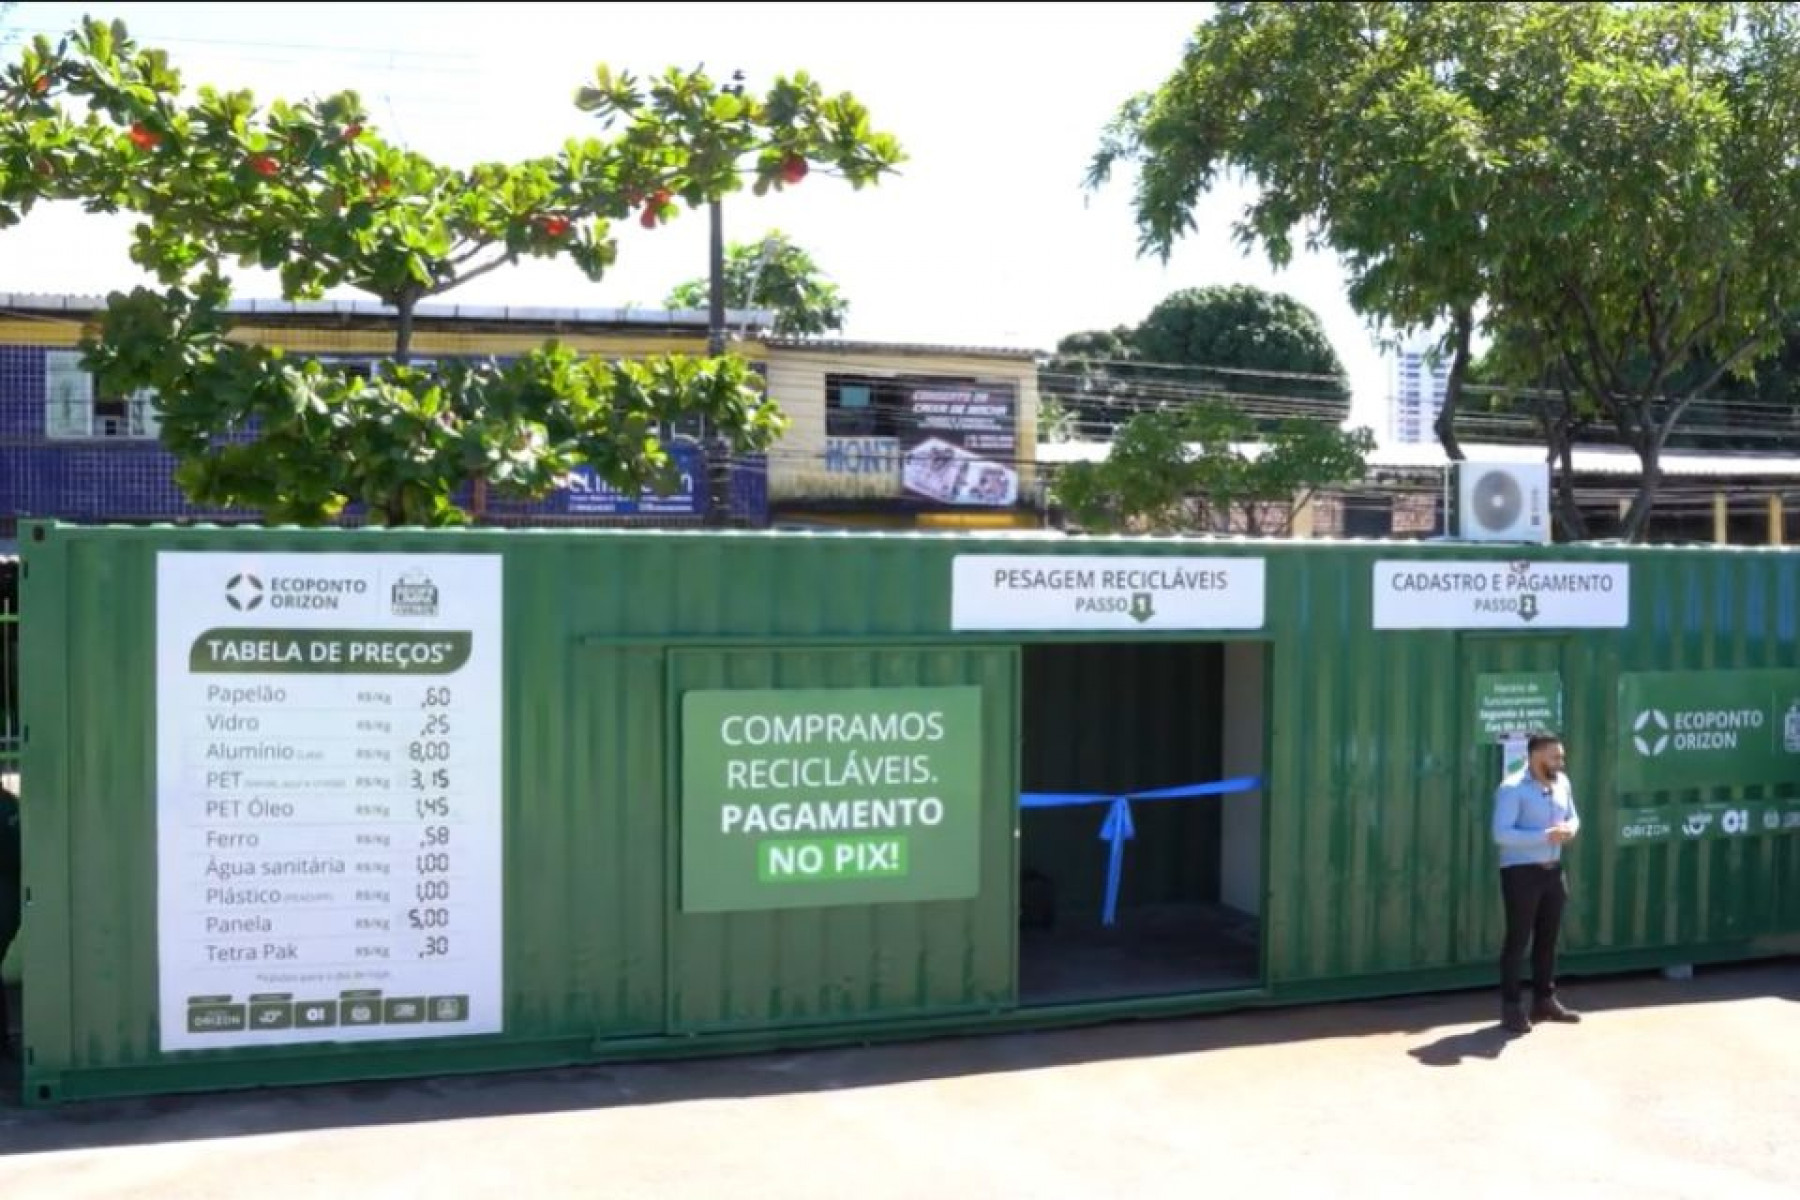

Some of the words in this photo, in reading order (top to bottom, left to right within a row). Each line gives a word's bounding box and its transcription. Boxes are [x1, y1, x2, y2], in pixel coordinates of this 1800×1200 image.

[271, 578, 368, 595] ECOPONTO
[994, 568, 1095, 590] PESAGEM
[1102, 565, 1228, 591] RECICLÁVEIS
[1391, 573, 1487, 593] CADASTRO
[1492, 574, 1502, 592] E
[1506, 573, 1614, 593] PAGAMENTO
[271, 595, 339, 610] ORIZON
[1075, 597, 1128, 613] PASSO
[1474, 598, 1517, 613] PASSO
[206, 640, 303, 662] TABELA
[310, 641, 342, 663] DE
[207, 684, 287, 703] Papelão
[206, 715, 259, 732] Vidro
[721, 712, 944, 745] COMPRAMOS
[1674, 710, 1764, 730] ECOPONTO
[1674, 731, 1738, 750] ORIZON
[206, 742, 294, 760] Alumínio
[409, 741, 450, 764] 8,00
[727, 750, 938, 789] RECICLÁVEIS.
[206, 771, 242, 789] PET
[206, 801, 242, 817] PET
[248, 797, 294, 817] Óleo
[721, 797, 943, 834] PAGAMENTO
[206, 831, 259, 848] Ferro
[206, 858, 256, 880] Água
[262, 856, 346, 874] sanitária
[769, 845, 824, 875] NO
[834, 842, 900, 872] PIX!
[206, 887, 281, 905] Plástico
[206, 915, 272, 933] Panela
[409, 909, 449, 930] 5,00
[206, 944, 258, 961] Tetra
[264, 942, 298, 960] Pak
